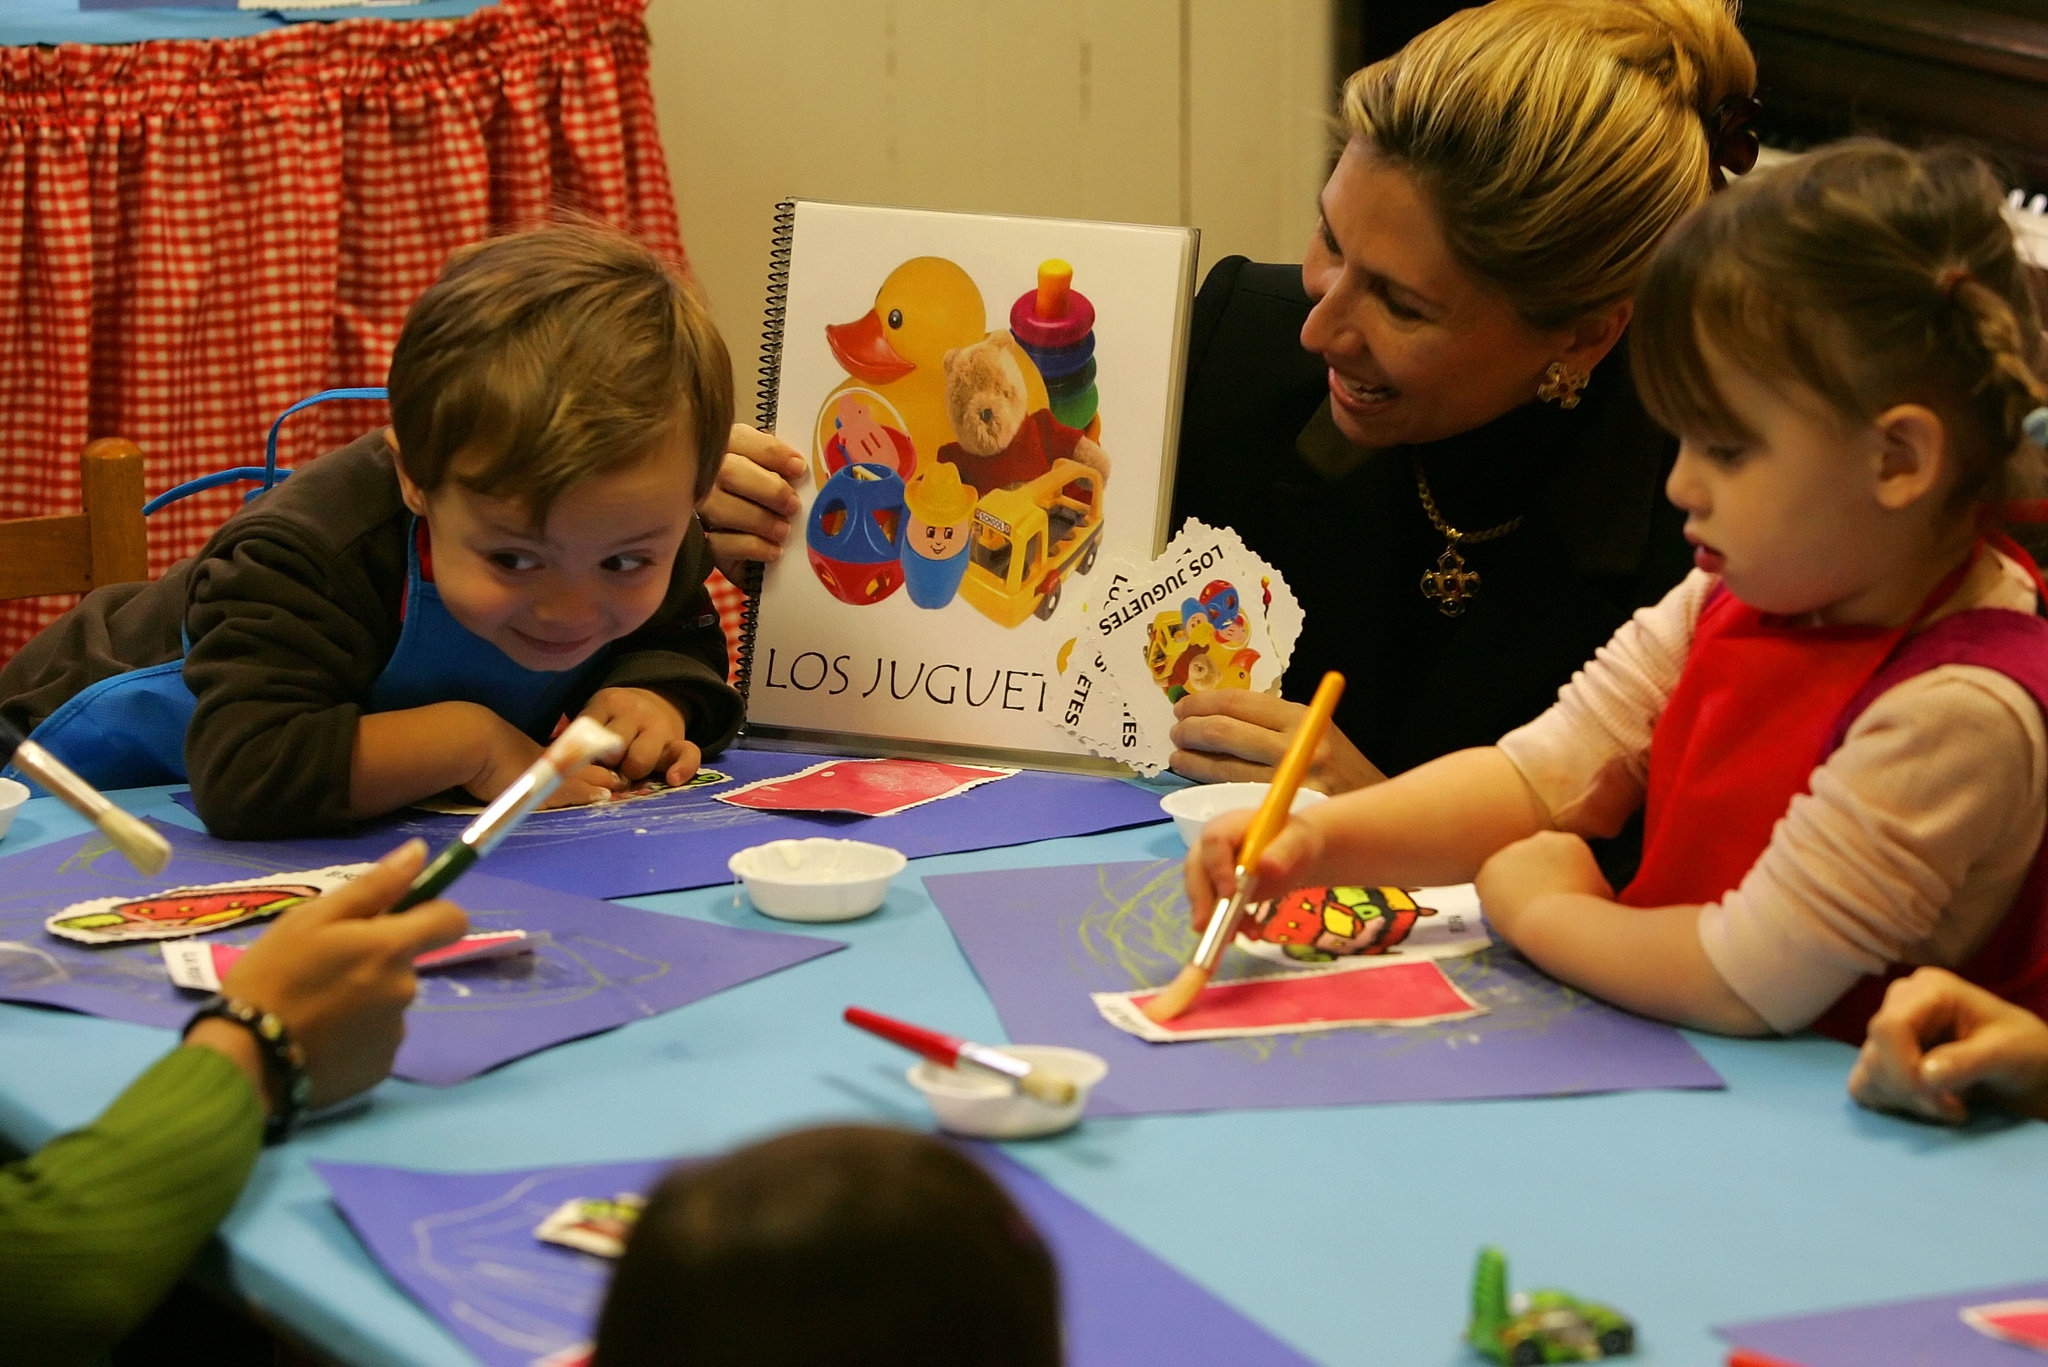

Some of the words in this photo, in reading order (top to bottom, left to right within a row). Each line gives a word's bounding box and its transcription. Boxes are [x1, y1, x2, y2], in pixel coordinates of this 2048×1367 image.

[1189, 544, 1225, 578] LOS
[1099, 567, 1188, 636] JUGUETES
[765, 648, 850, 695] LOS
